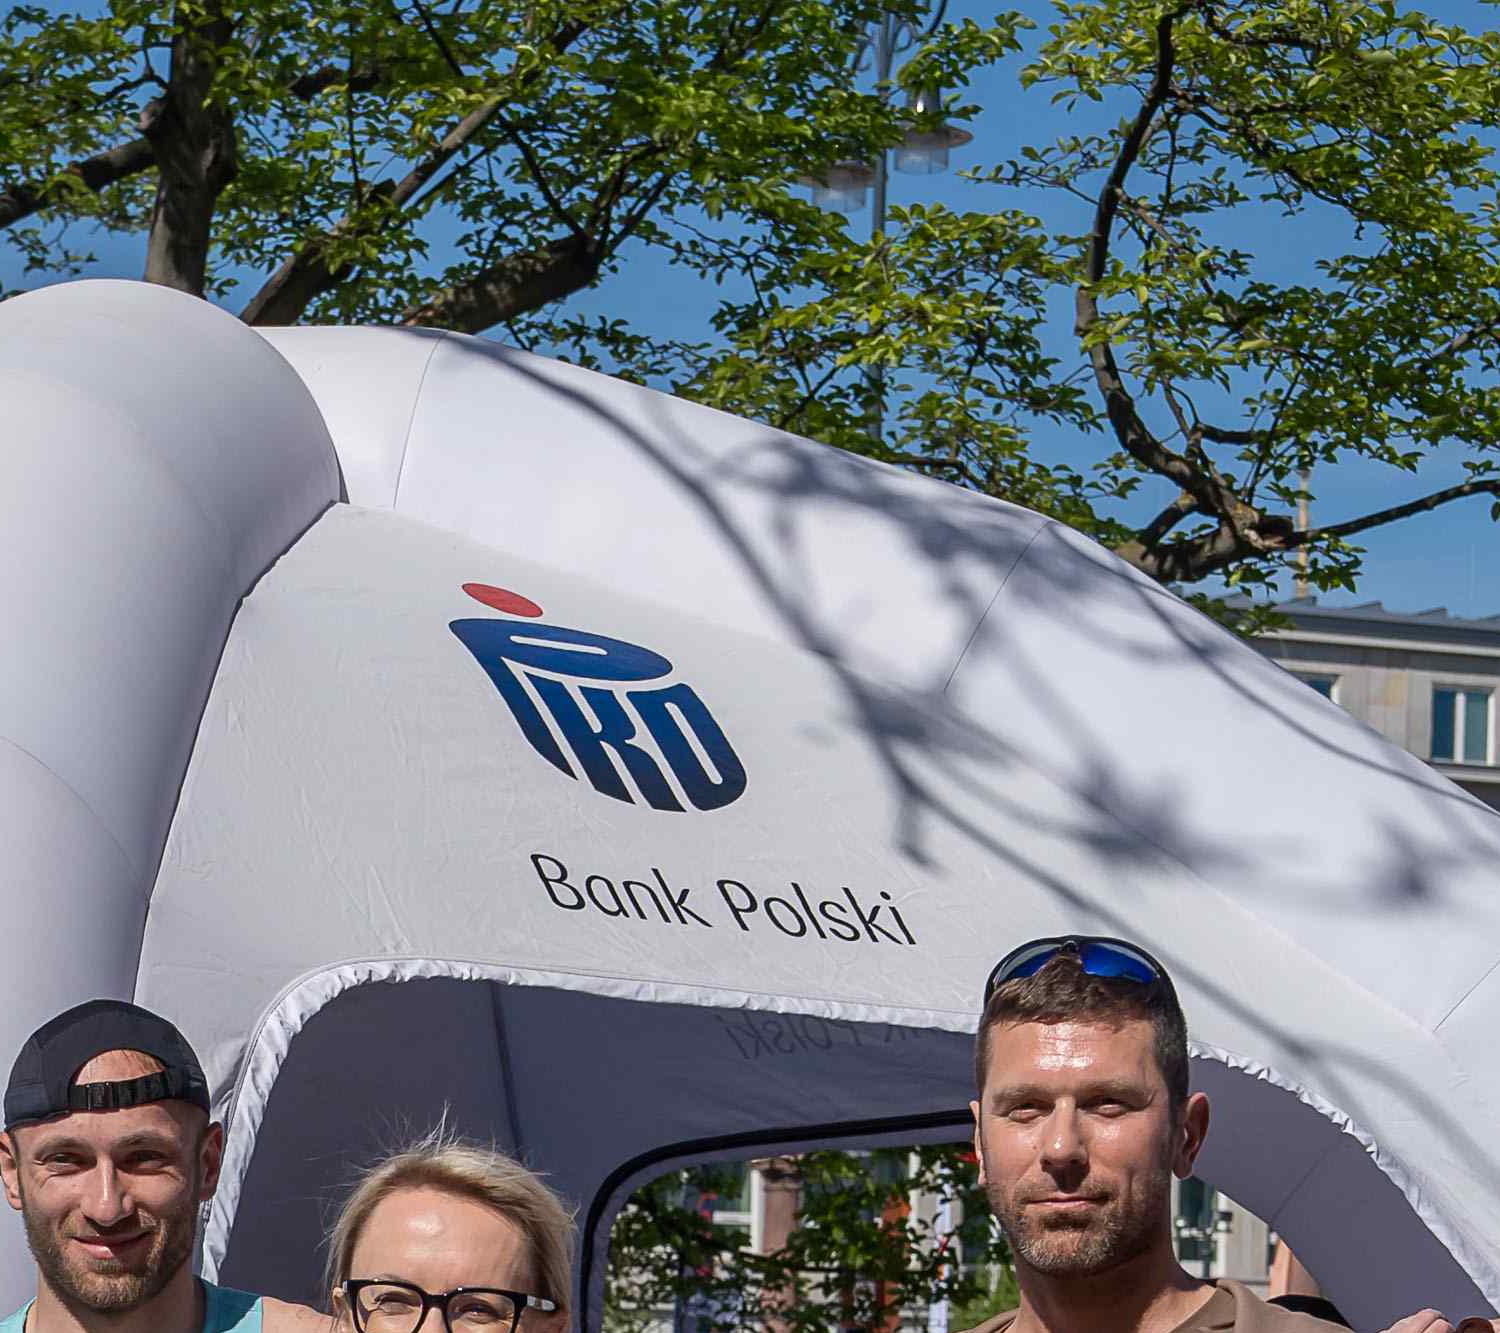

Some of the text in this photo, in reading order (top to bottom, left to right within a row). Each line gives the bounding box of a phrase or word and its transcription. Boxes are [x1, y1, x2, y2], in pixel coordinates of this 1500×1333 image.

[449, 619, 748, 812] PKO
[531, 854, 916, 945] Bank Polski
